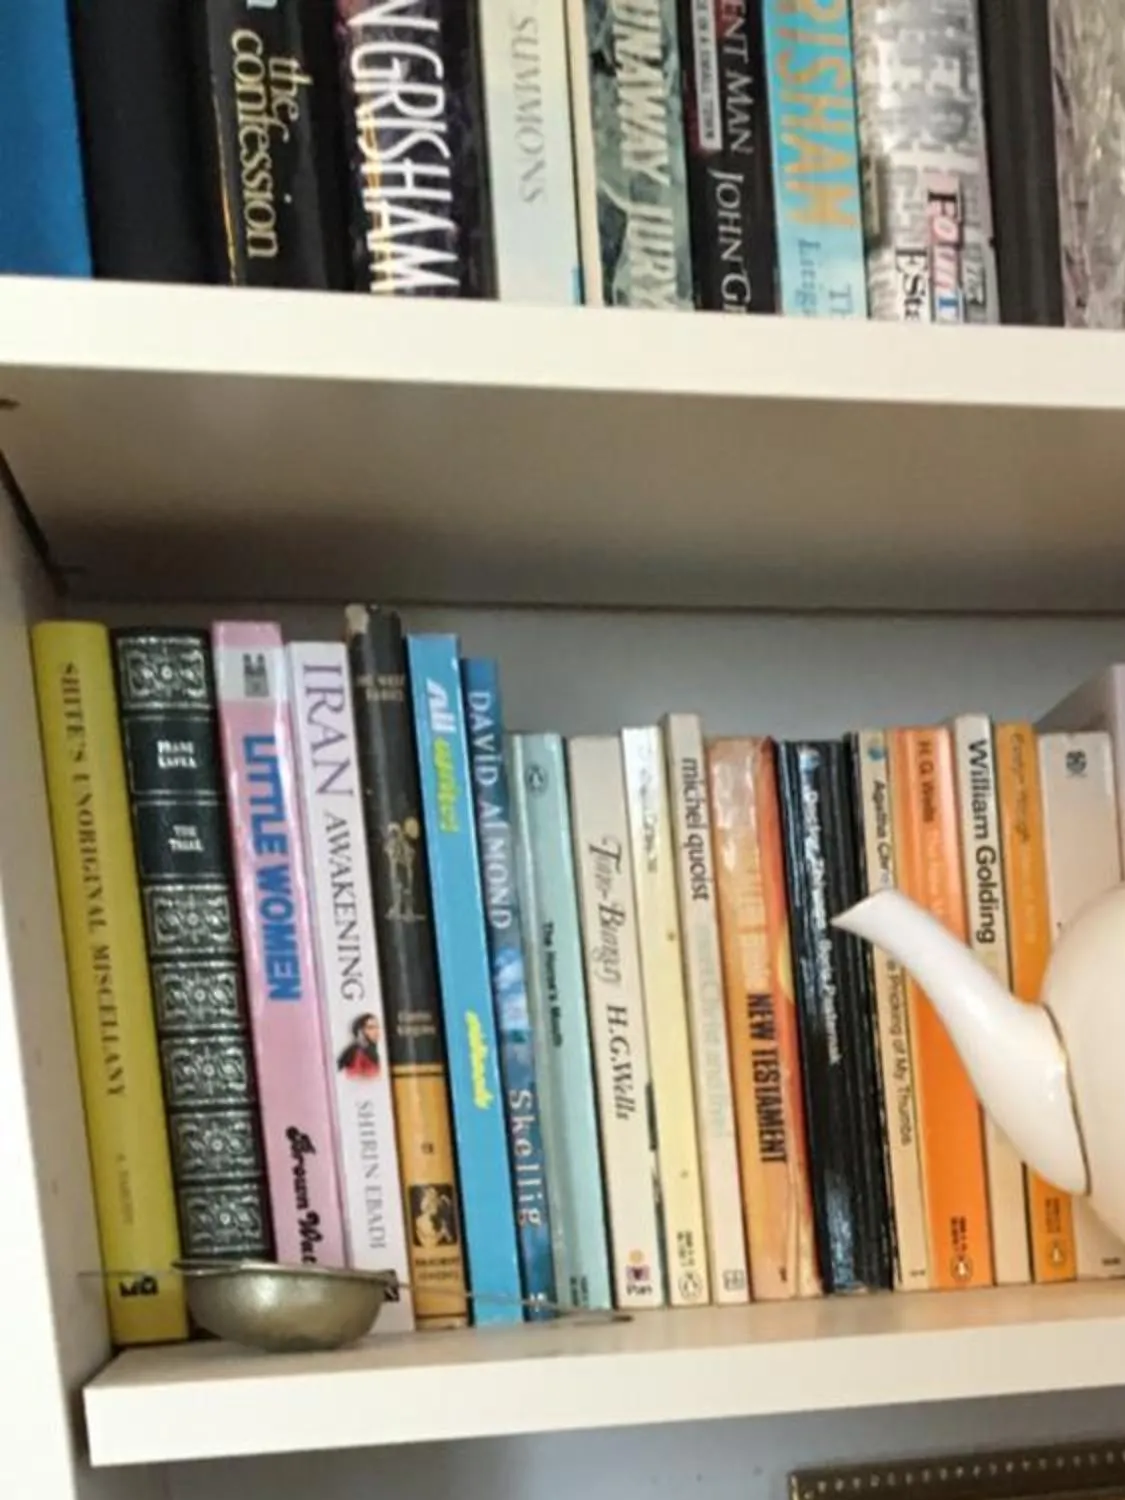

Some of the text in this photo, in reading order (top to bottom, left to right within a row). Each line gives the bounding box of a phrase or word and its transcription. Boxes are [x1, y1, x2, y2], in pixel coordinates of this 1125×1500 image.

[231, 28, 279, 259] confession
[269, 57, 313, 143] the
[350, 40, 461, 295] GRISHAM
[514, 14, 550, 206] SUMMONS
[611, 0, 671, 186] UNAWAY
[724, 71, 755, 155] MAN
[706, 168, 744, 262] JOHN
[242, 735, 289, 856] LITTLE
[302, 664, 366, 1002] IRAN AWAKENING
[467, 689, 513, 930] DAVID ALMOND
[680, 757, 710, 902] michel quoist
[967, 739, 999, 945] William Golding
[253, 863, 304, 1001] WOMEN
[92, 943, 126, 1096] MISCELLANY
[746, 993, 789, 1164] NEW TESTAMENT
[353, 1099, 388, 1250] SHIRIN EBADI
[507, 1088, 544, 1229] Skellig
[896, 1086, 913, 1146] Thumbs
[298, 1210, 323, 1265] Wat
